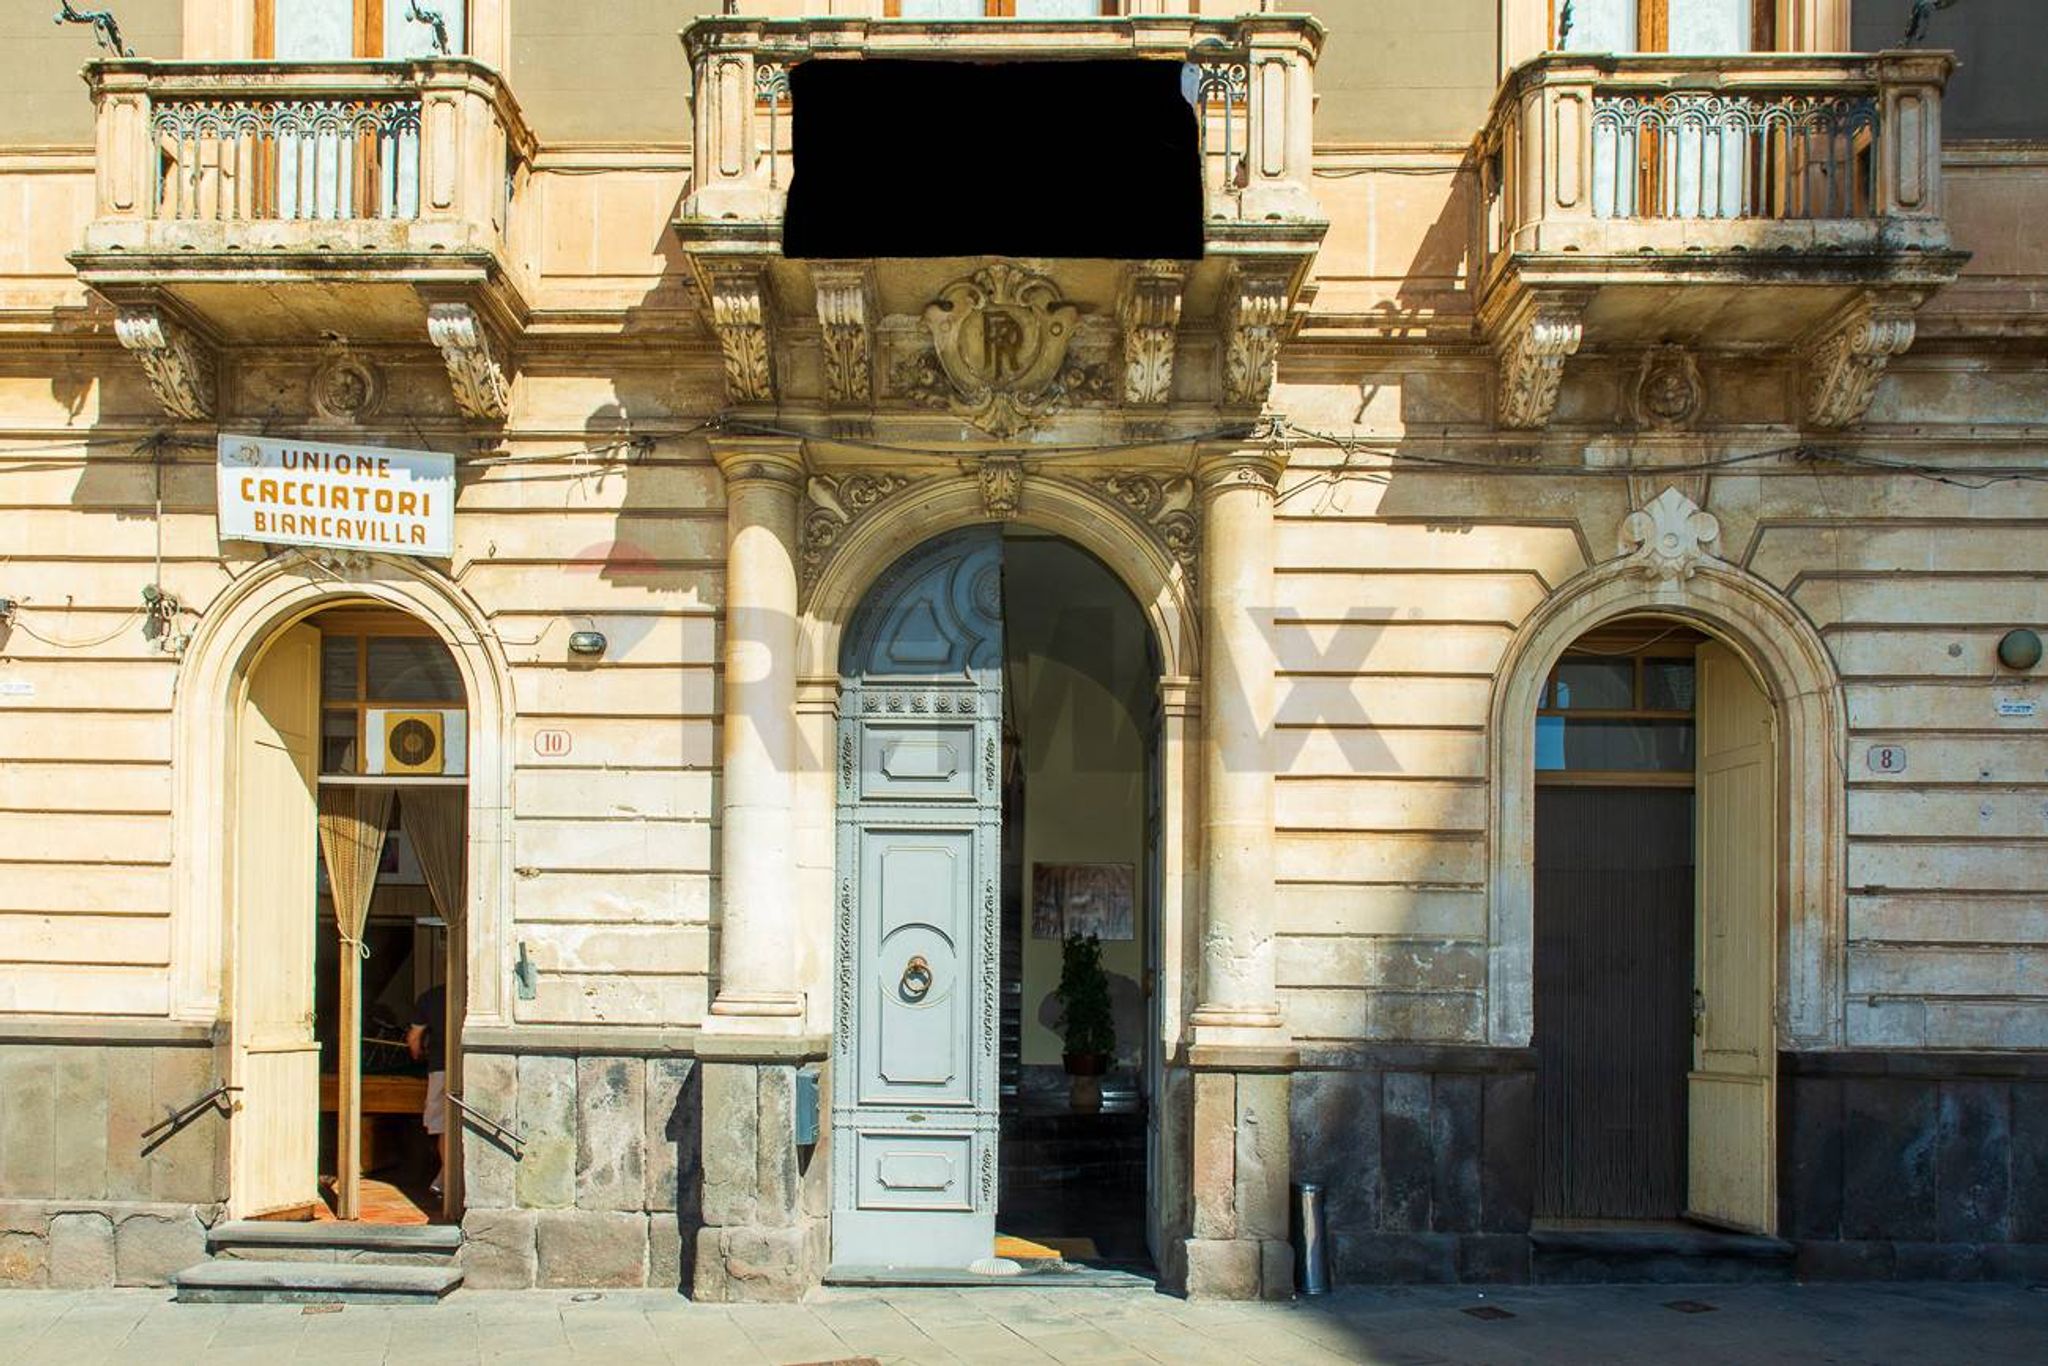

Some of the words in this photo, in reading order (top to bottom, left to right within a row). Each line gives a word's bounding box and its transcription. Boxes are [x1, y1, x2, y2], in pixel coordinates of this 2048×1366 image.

[281, 449, 391, 479] UNIONE
[240, 477, 430, 517] CACCIATORI
[253, 510, 426, 545] BIANCAVILLA
[545, 733, 562, 752] 10
[1881, 748, 1892, 769] 8
